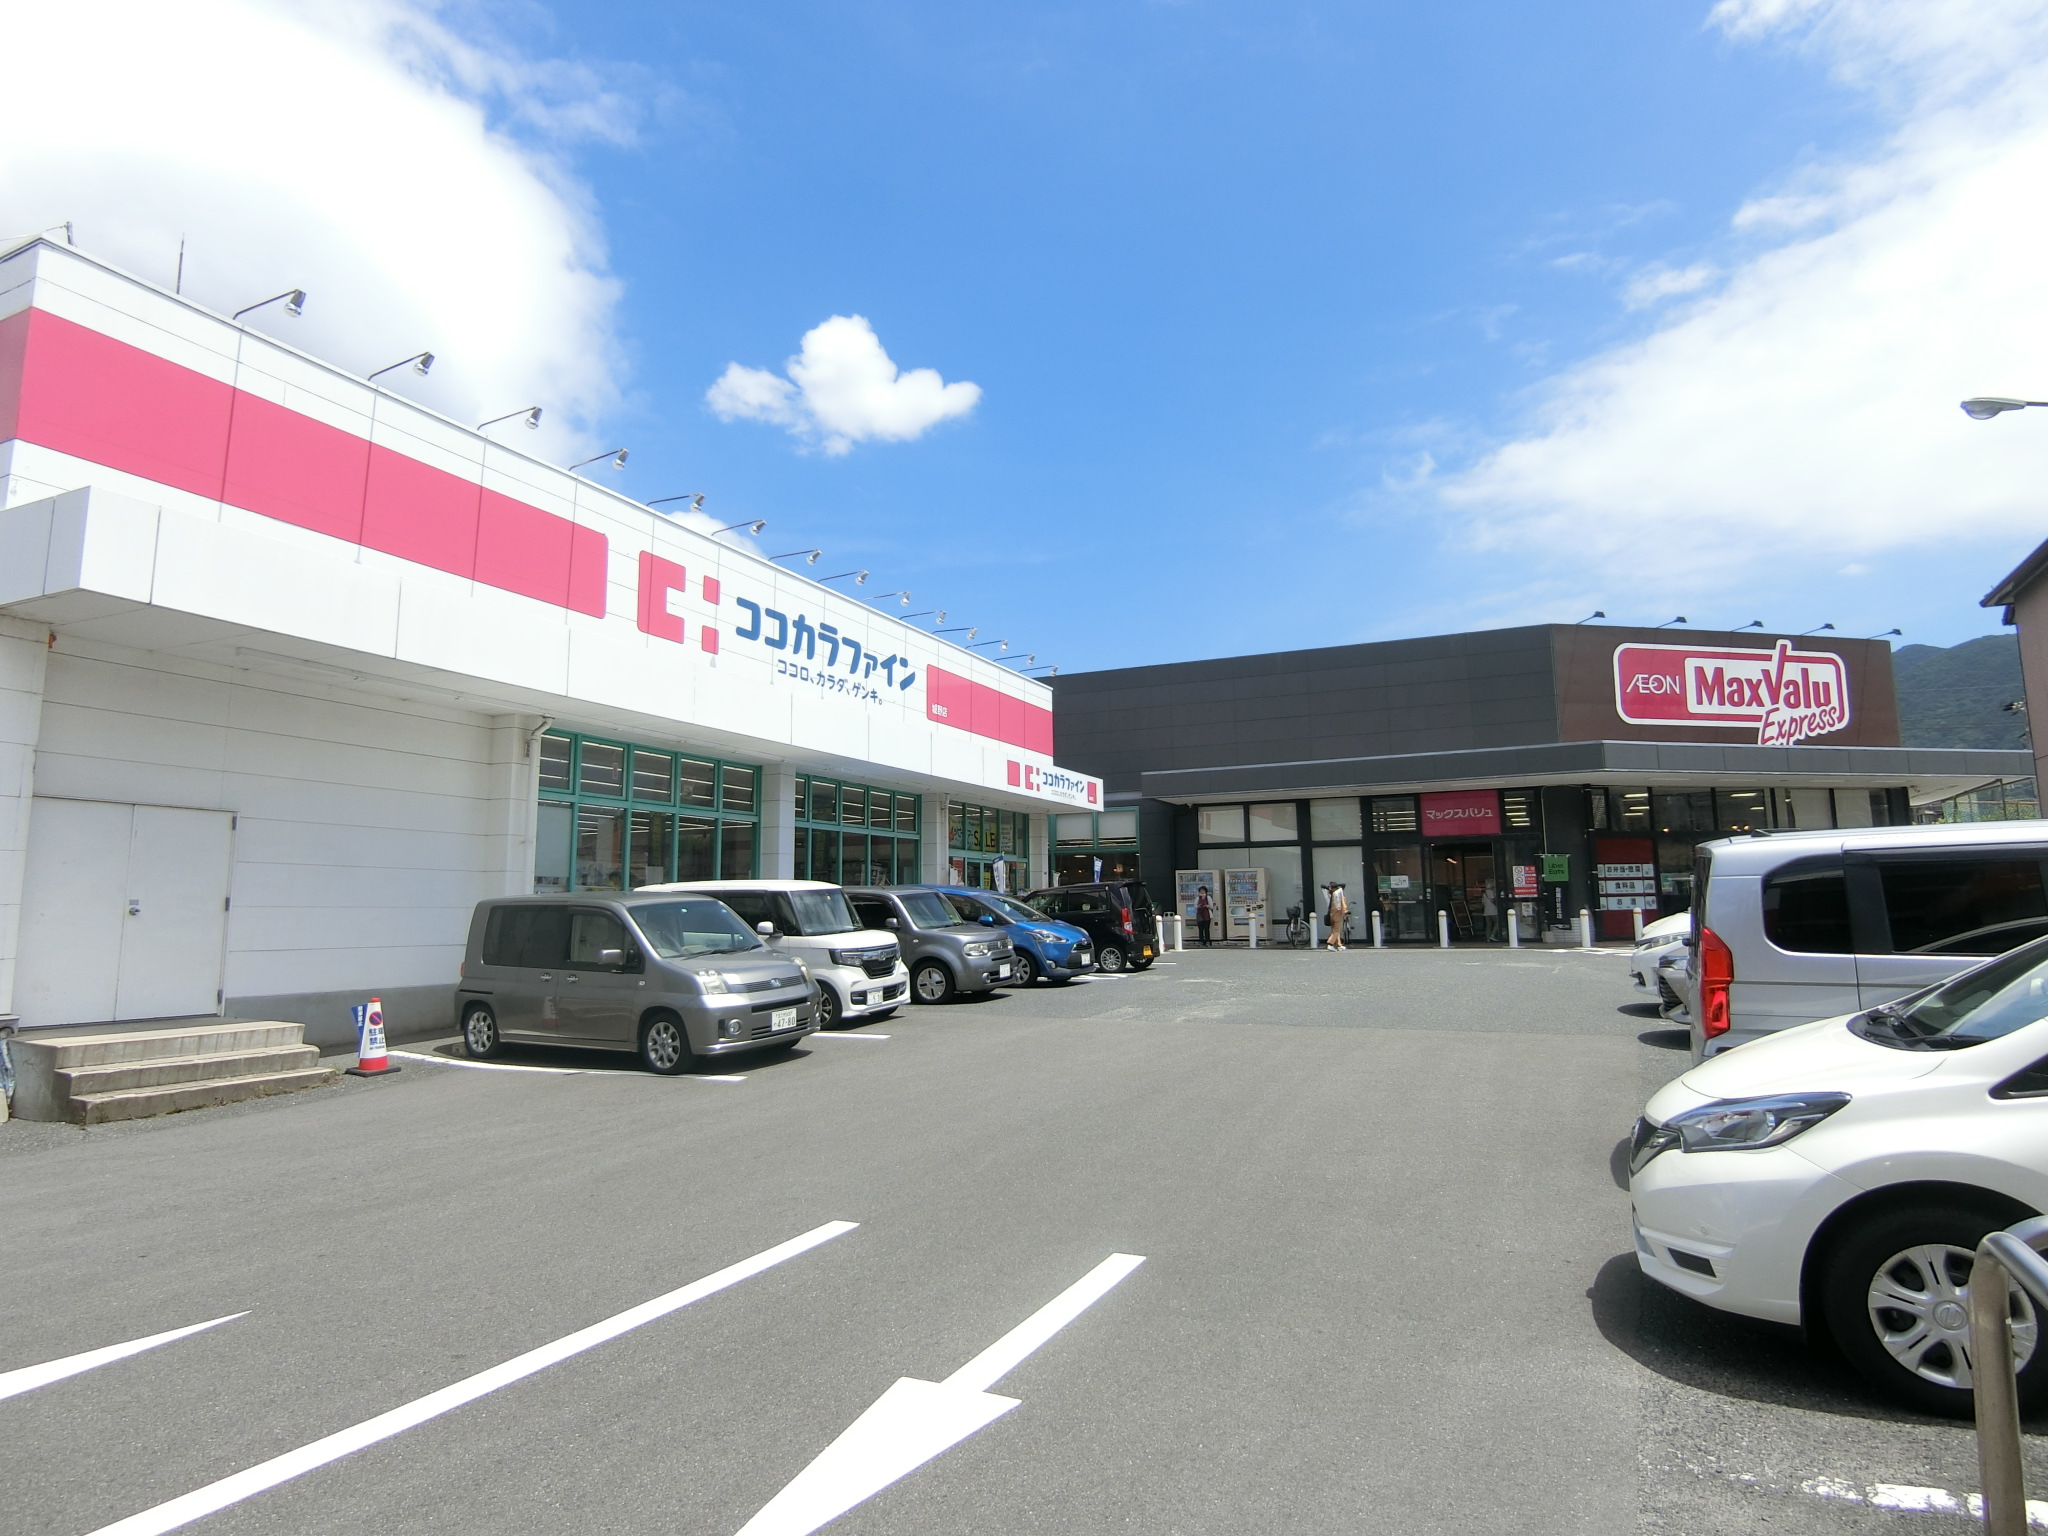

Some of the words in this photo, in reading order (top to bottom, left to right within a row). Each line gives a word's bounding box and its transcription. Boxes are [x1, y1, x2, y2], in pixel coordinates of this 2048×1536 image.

[736, 597, 916, 691] ココカラファイン
[777, 659, 883, 705] ココロ、カラダ、ゲンキ。
[1694, 643, 1832, 709] MaxValu
[1760, 706, 1838, 745] Express
[1042, 772, 1085, 793] ココカラファイン
[1425, 807, 1493, 819] マックスバリュ
[973, 830, 996, 848] SLE
